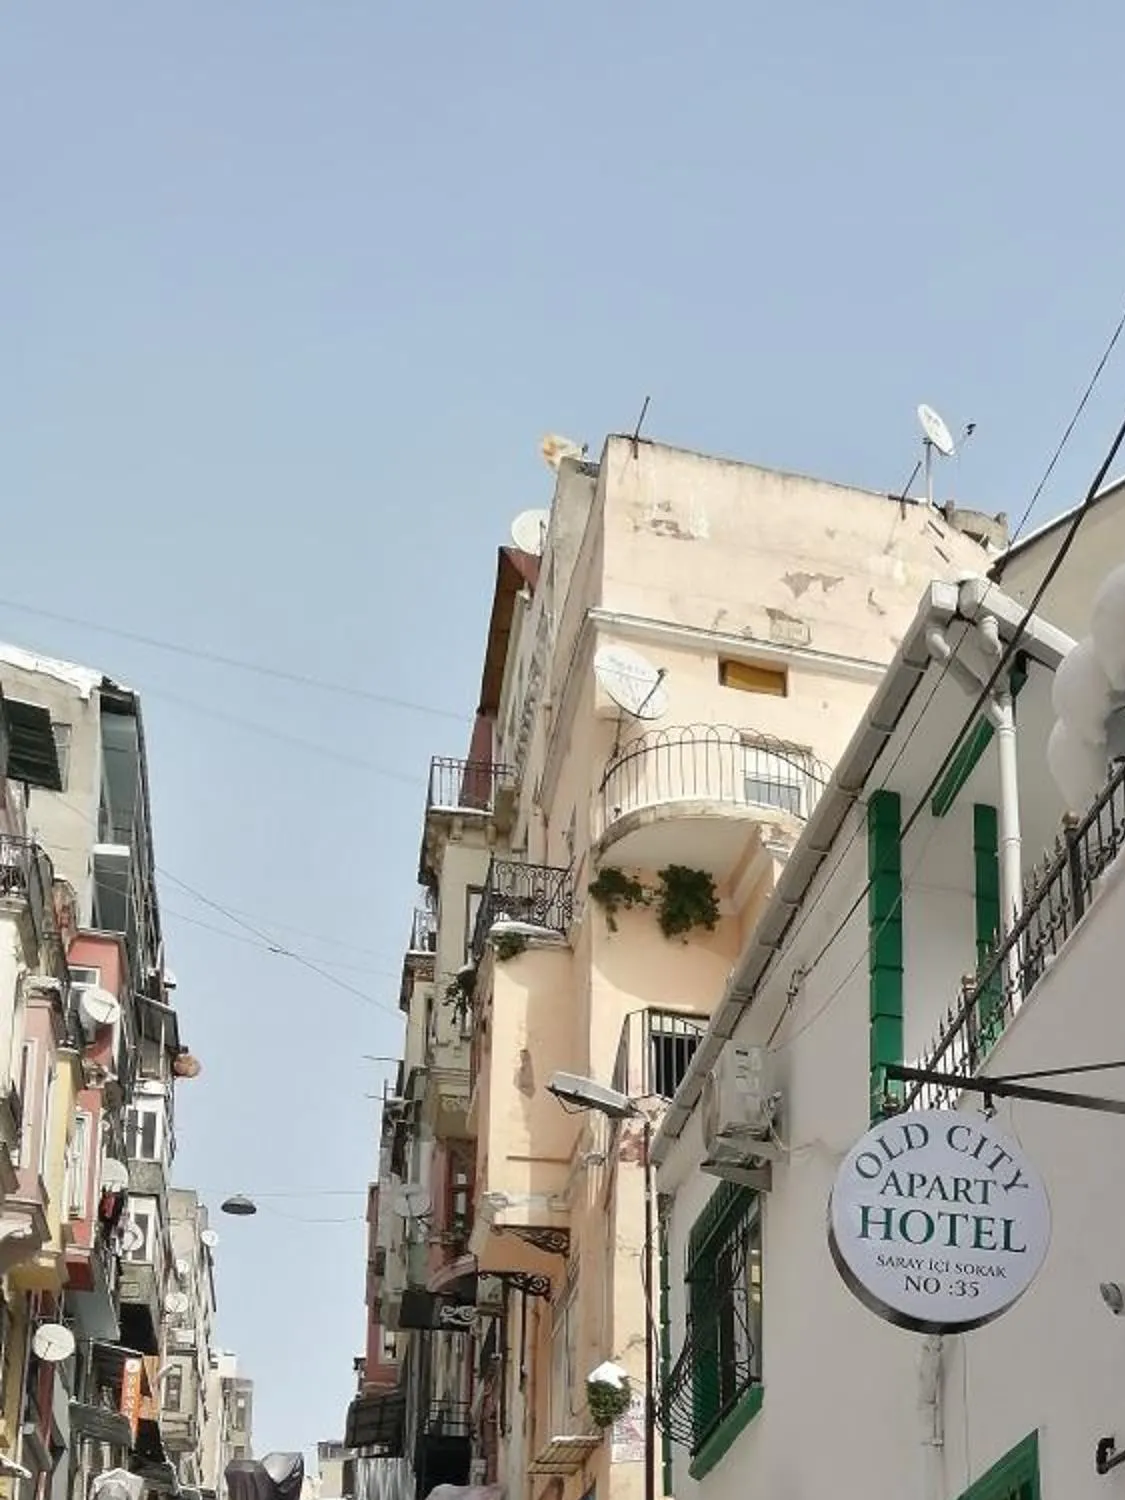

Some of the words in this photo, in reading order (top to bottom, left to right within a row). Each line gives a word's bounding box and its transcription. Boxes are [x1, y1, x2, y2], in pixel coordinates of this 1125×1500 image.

[855, 1123, 929, 1179] OLD
[946, 1125, 1029, 1192] CITY
[880, 1169, 997, 1205] APART
[857, 1204, 1027, 1253] HOTEL
[876, 1254, 924, 1270] SARAY
[955, 1262, 1007, 1278] SOKAK
[905, 1275, 941, 1294] NO
